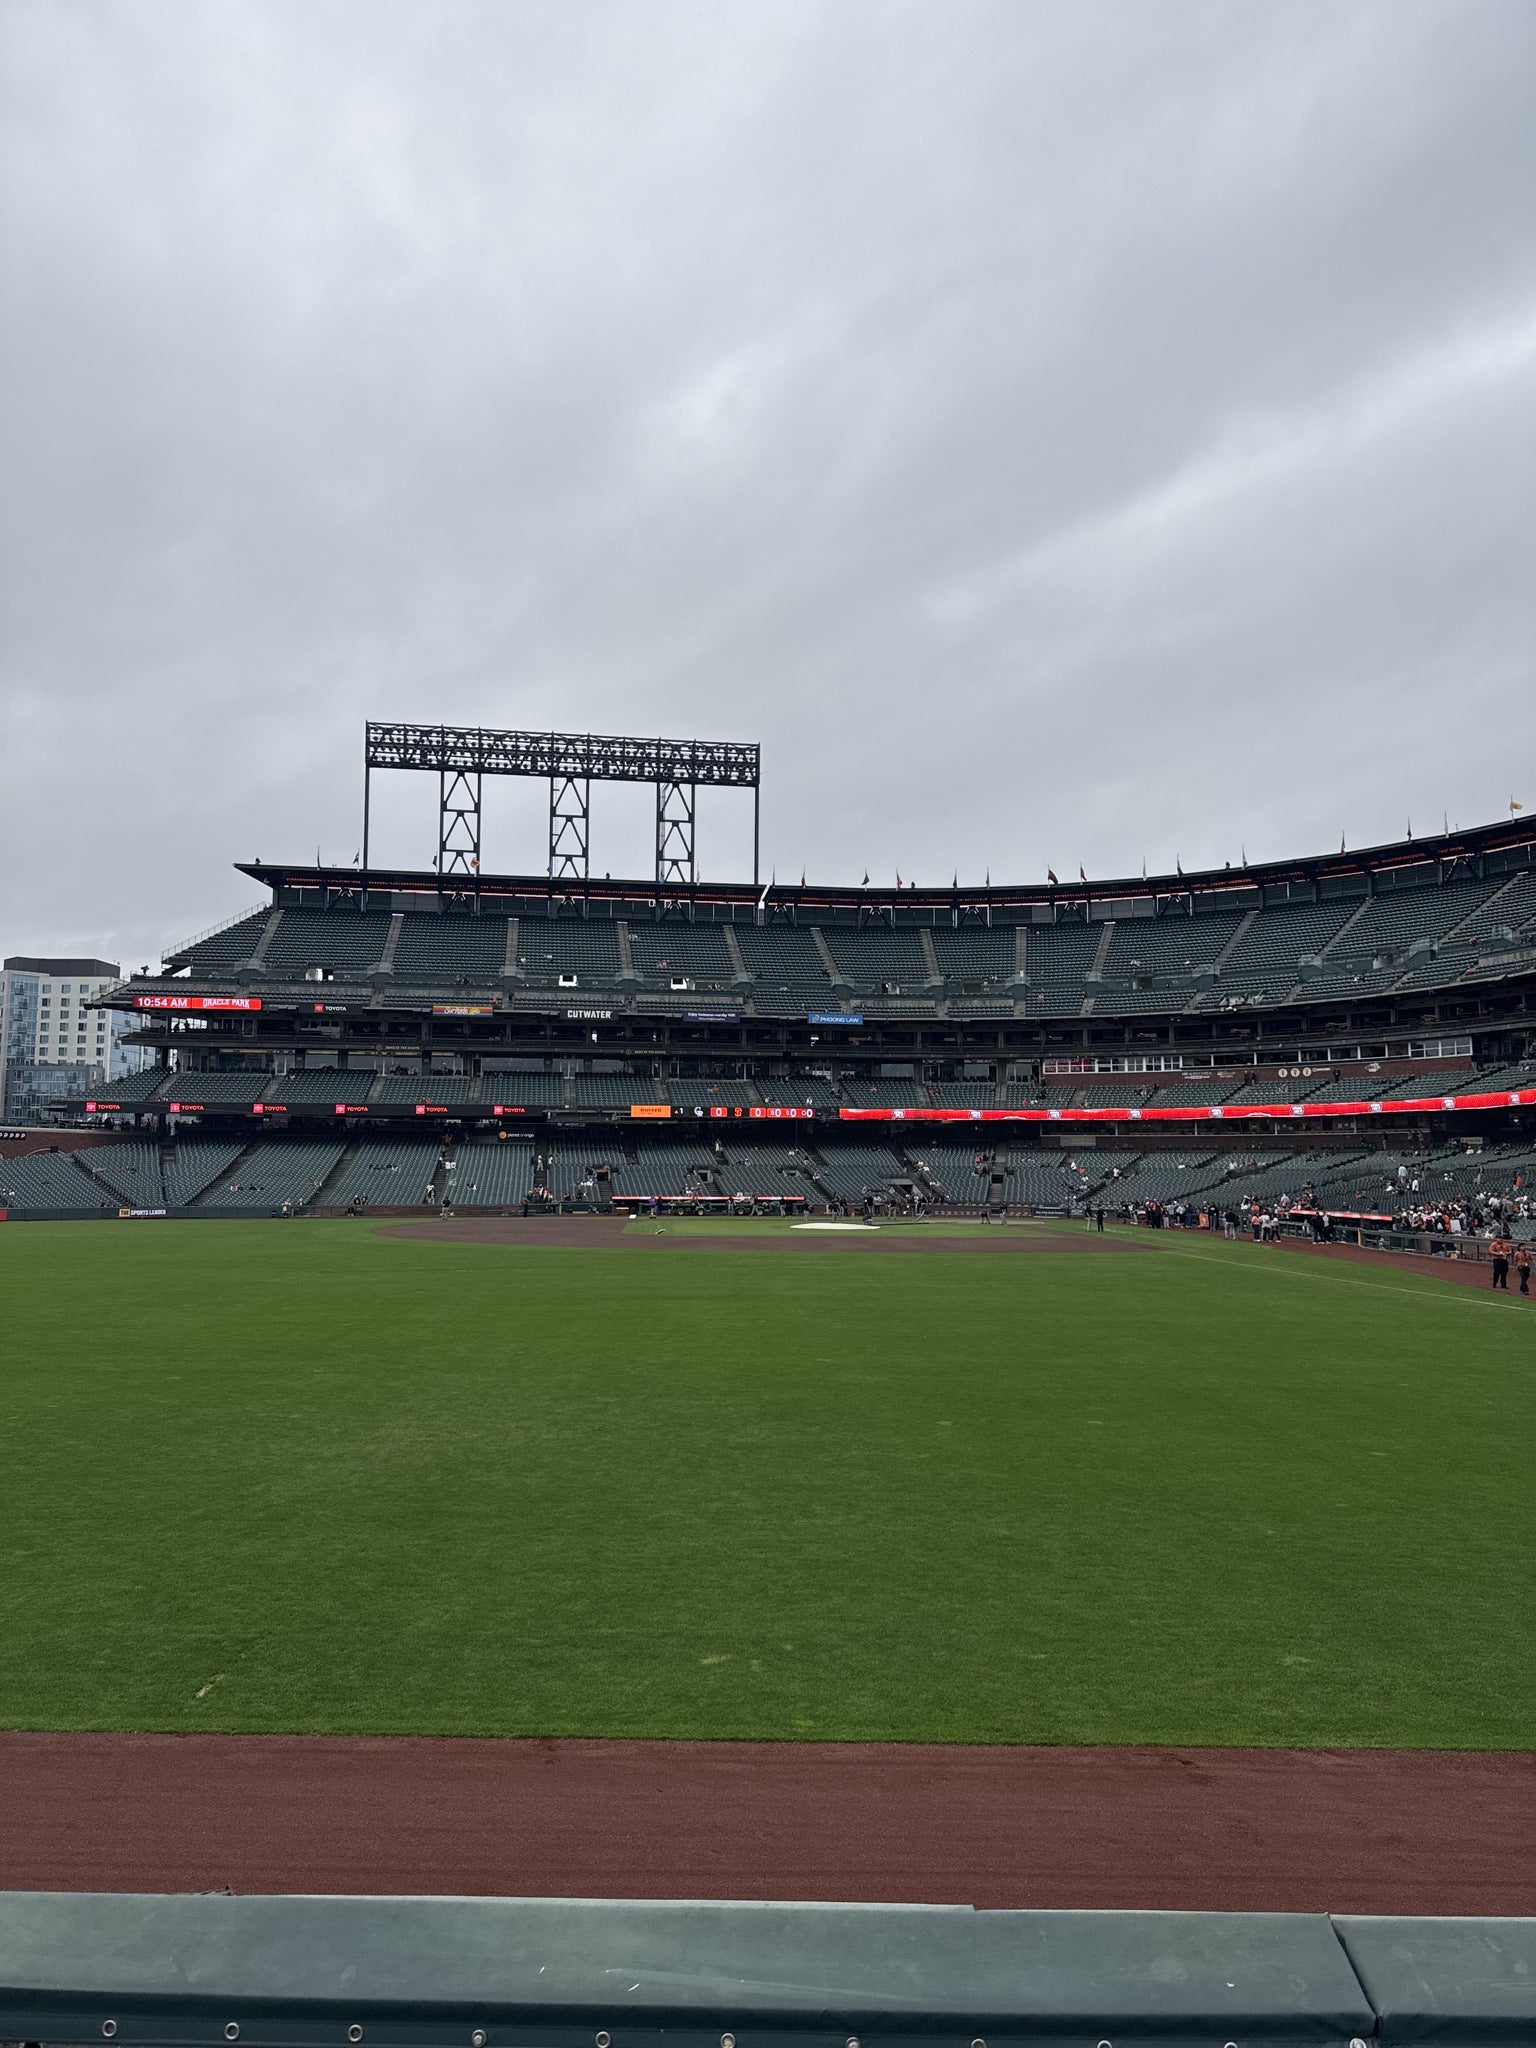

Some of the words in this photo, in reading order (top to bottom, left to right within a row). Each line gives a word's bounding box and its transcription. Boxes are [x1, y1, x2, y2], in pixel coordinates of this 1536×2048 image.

[138, 998, 167, 1007] 10:54
[170, 998, 187, 1007] AM
[203, 998, 229, 1008] ORACLE
[231, 998, 250, 1008] PARK
[567, 1010, 611, 1018] CUTWATER
[715, 1107, 722, 1117] 0
[755, 1108, 761, 1117] 0
